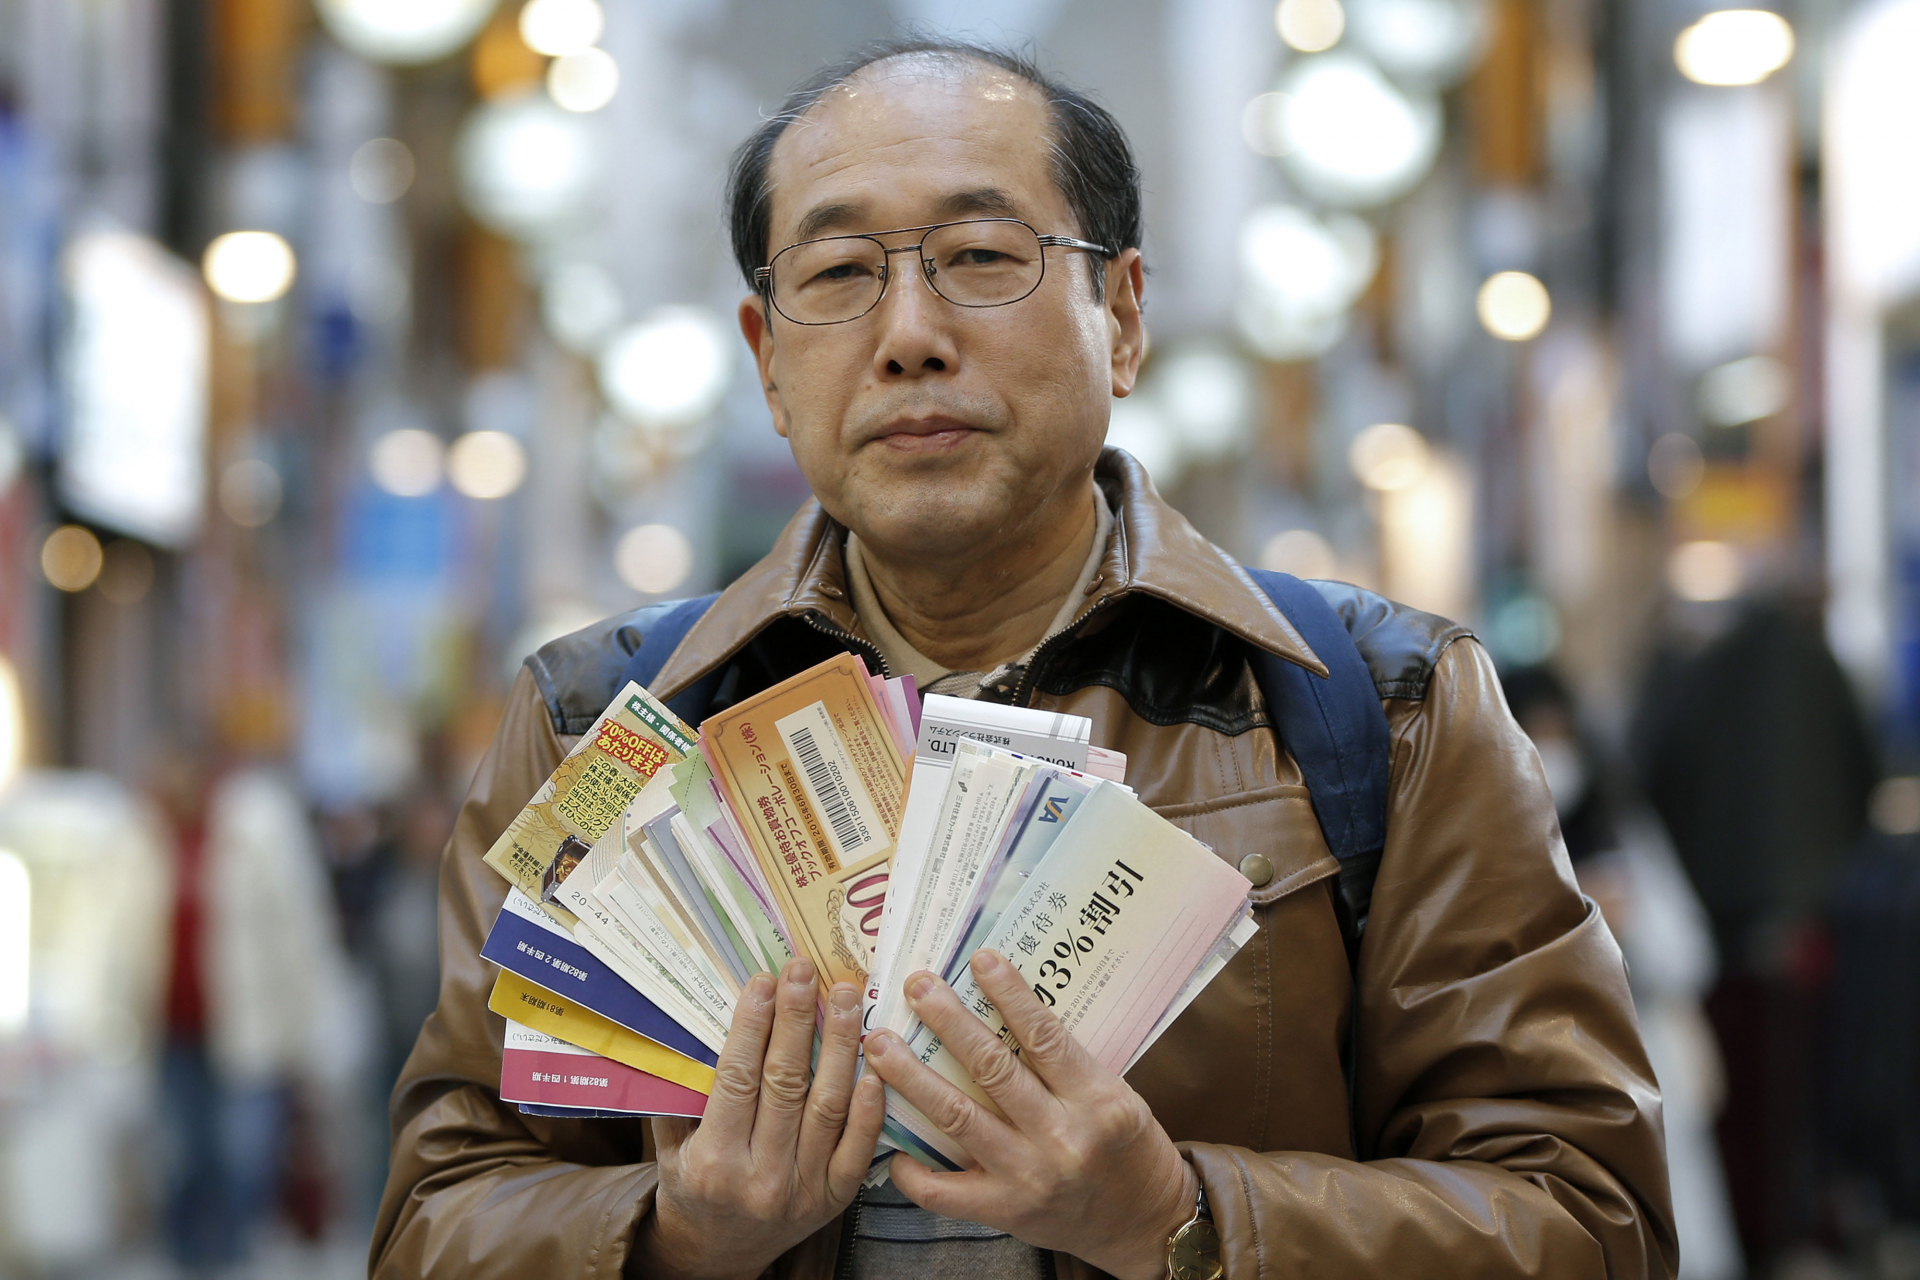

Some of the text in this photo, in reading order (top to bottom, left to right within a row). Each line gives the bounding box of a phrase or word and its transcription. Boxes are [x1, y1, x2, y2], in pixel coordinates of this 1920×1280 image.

[601, 718, 666, 765] 70%OFFは
[926, 738, 955, 754] LTD.
[576, 779, 622, 817] しかも今回は
[827, 759, 872, 842] 9301150610010202
[756, 794, 809, 888] 株主優待お買物券
[957, 879, 1050, 1006] 日本和ディングス株式会社
[971, 887, 1071, 1019] 株ご優待券
[519, 991, 564, 1016] 第81期期末
[1058, 947, 1115, 1024] 期限:2015年6月30日まで
[1063, 946, 1130, 1036] の注意事項をご確認ください。
